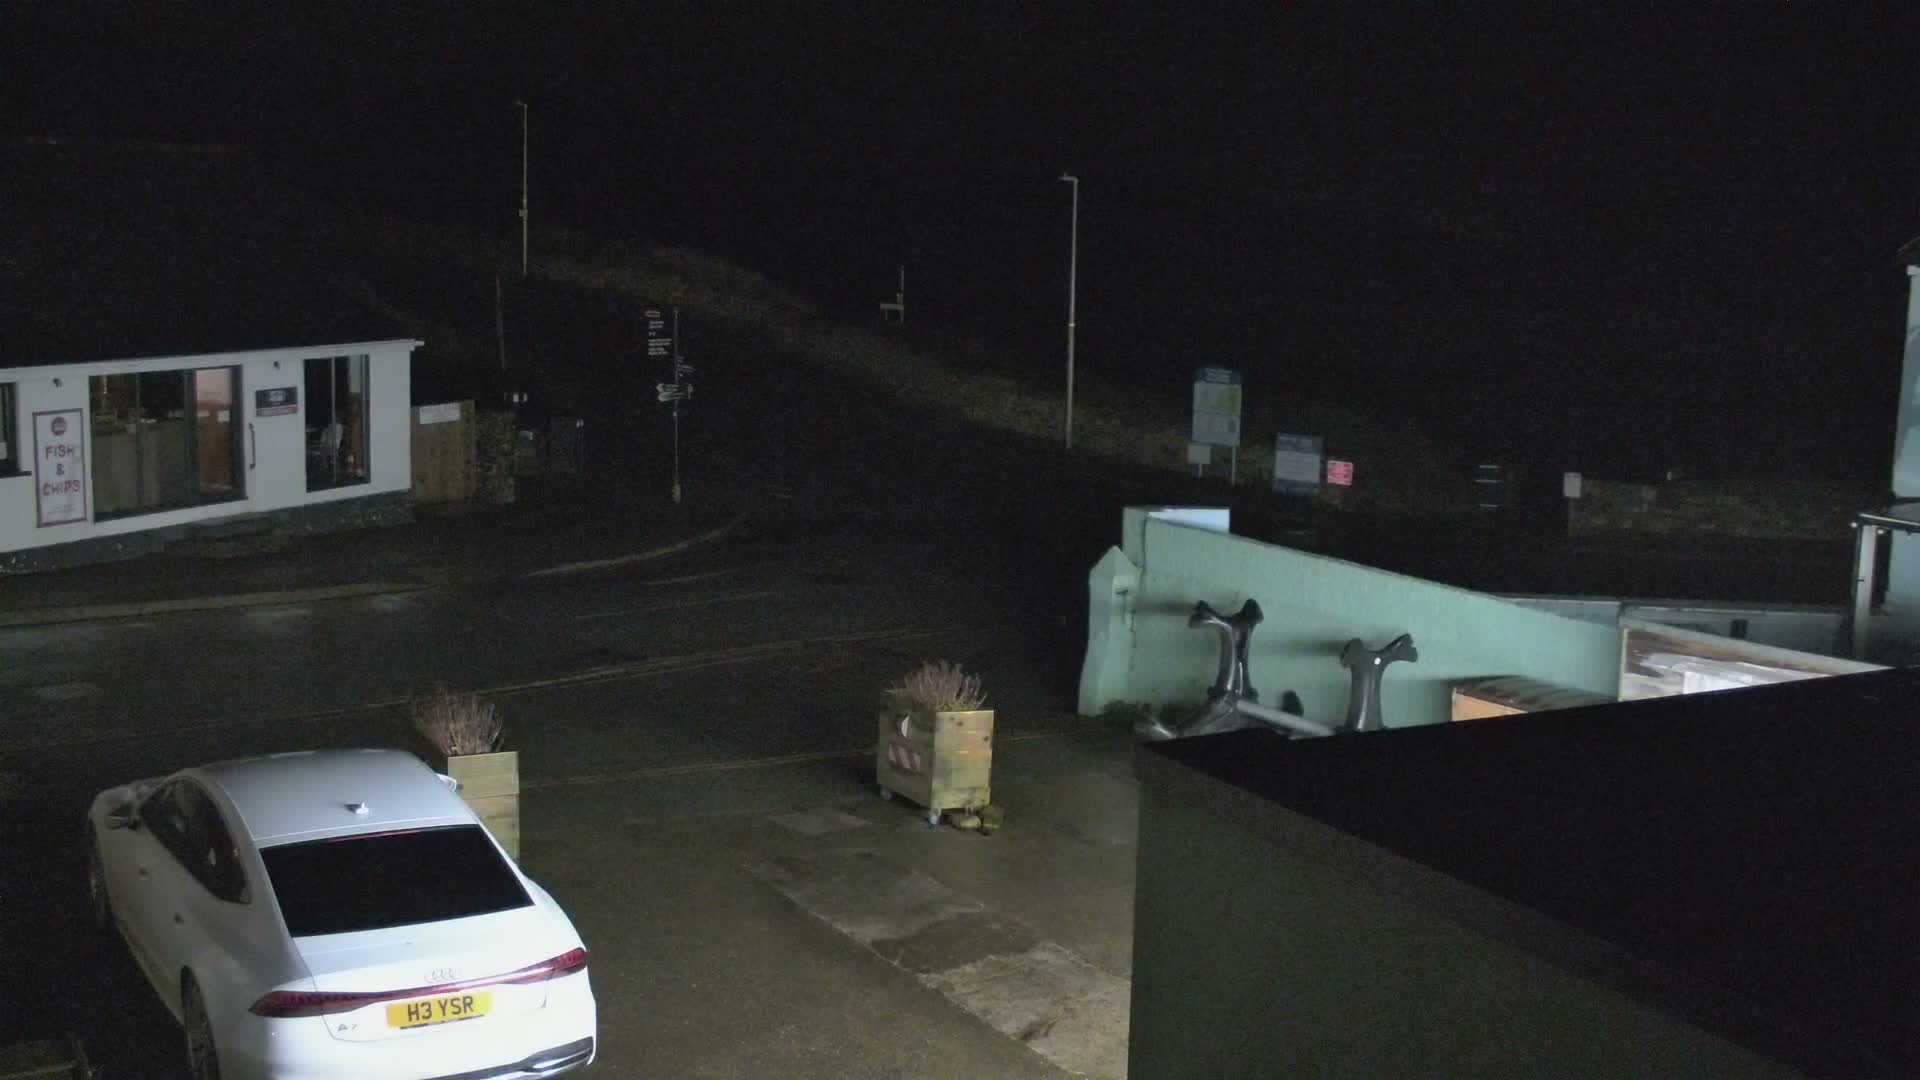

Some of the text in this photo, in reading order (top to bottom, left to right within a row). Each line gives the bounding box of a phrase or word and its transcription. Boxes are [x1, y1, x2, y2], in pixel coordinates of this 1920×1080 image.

[45, 445, 74, 460] FISH
[56, 463, 65, 476] &
[42, 479, 80, 496] CHIPS
[408, 996, 474, 1022] H3 YSR
